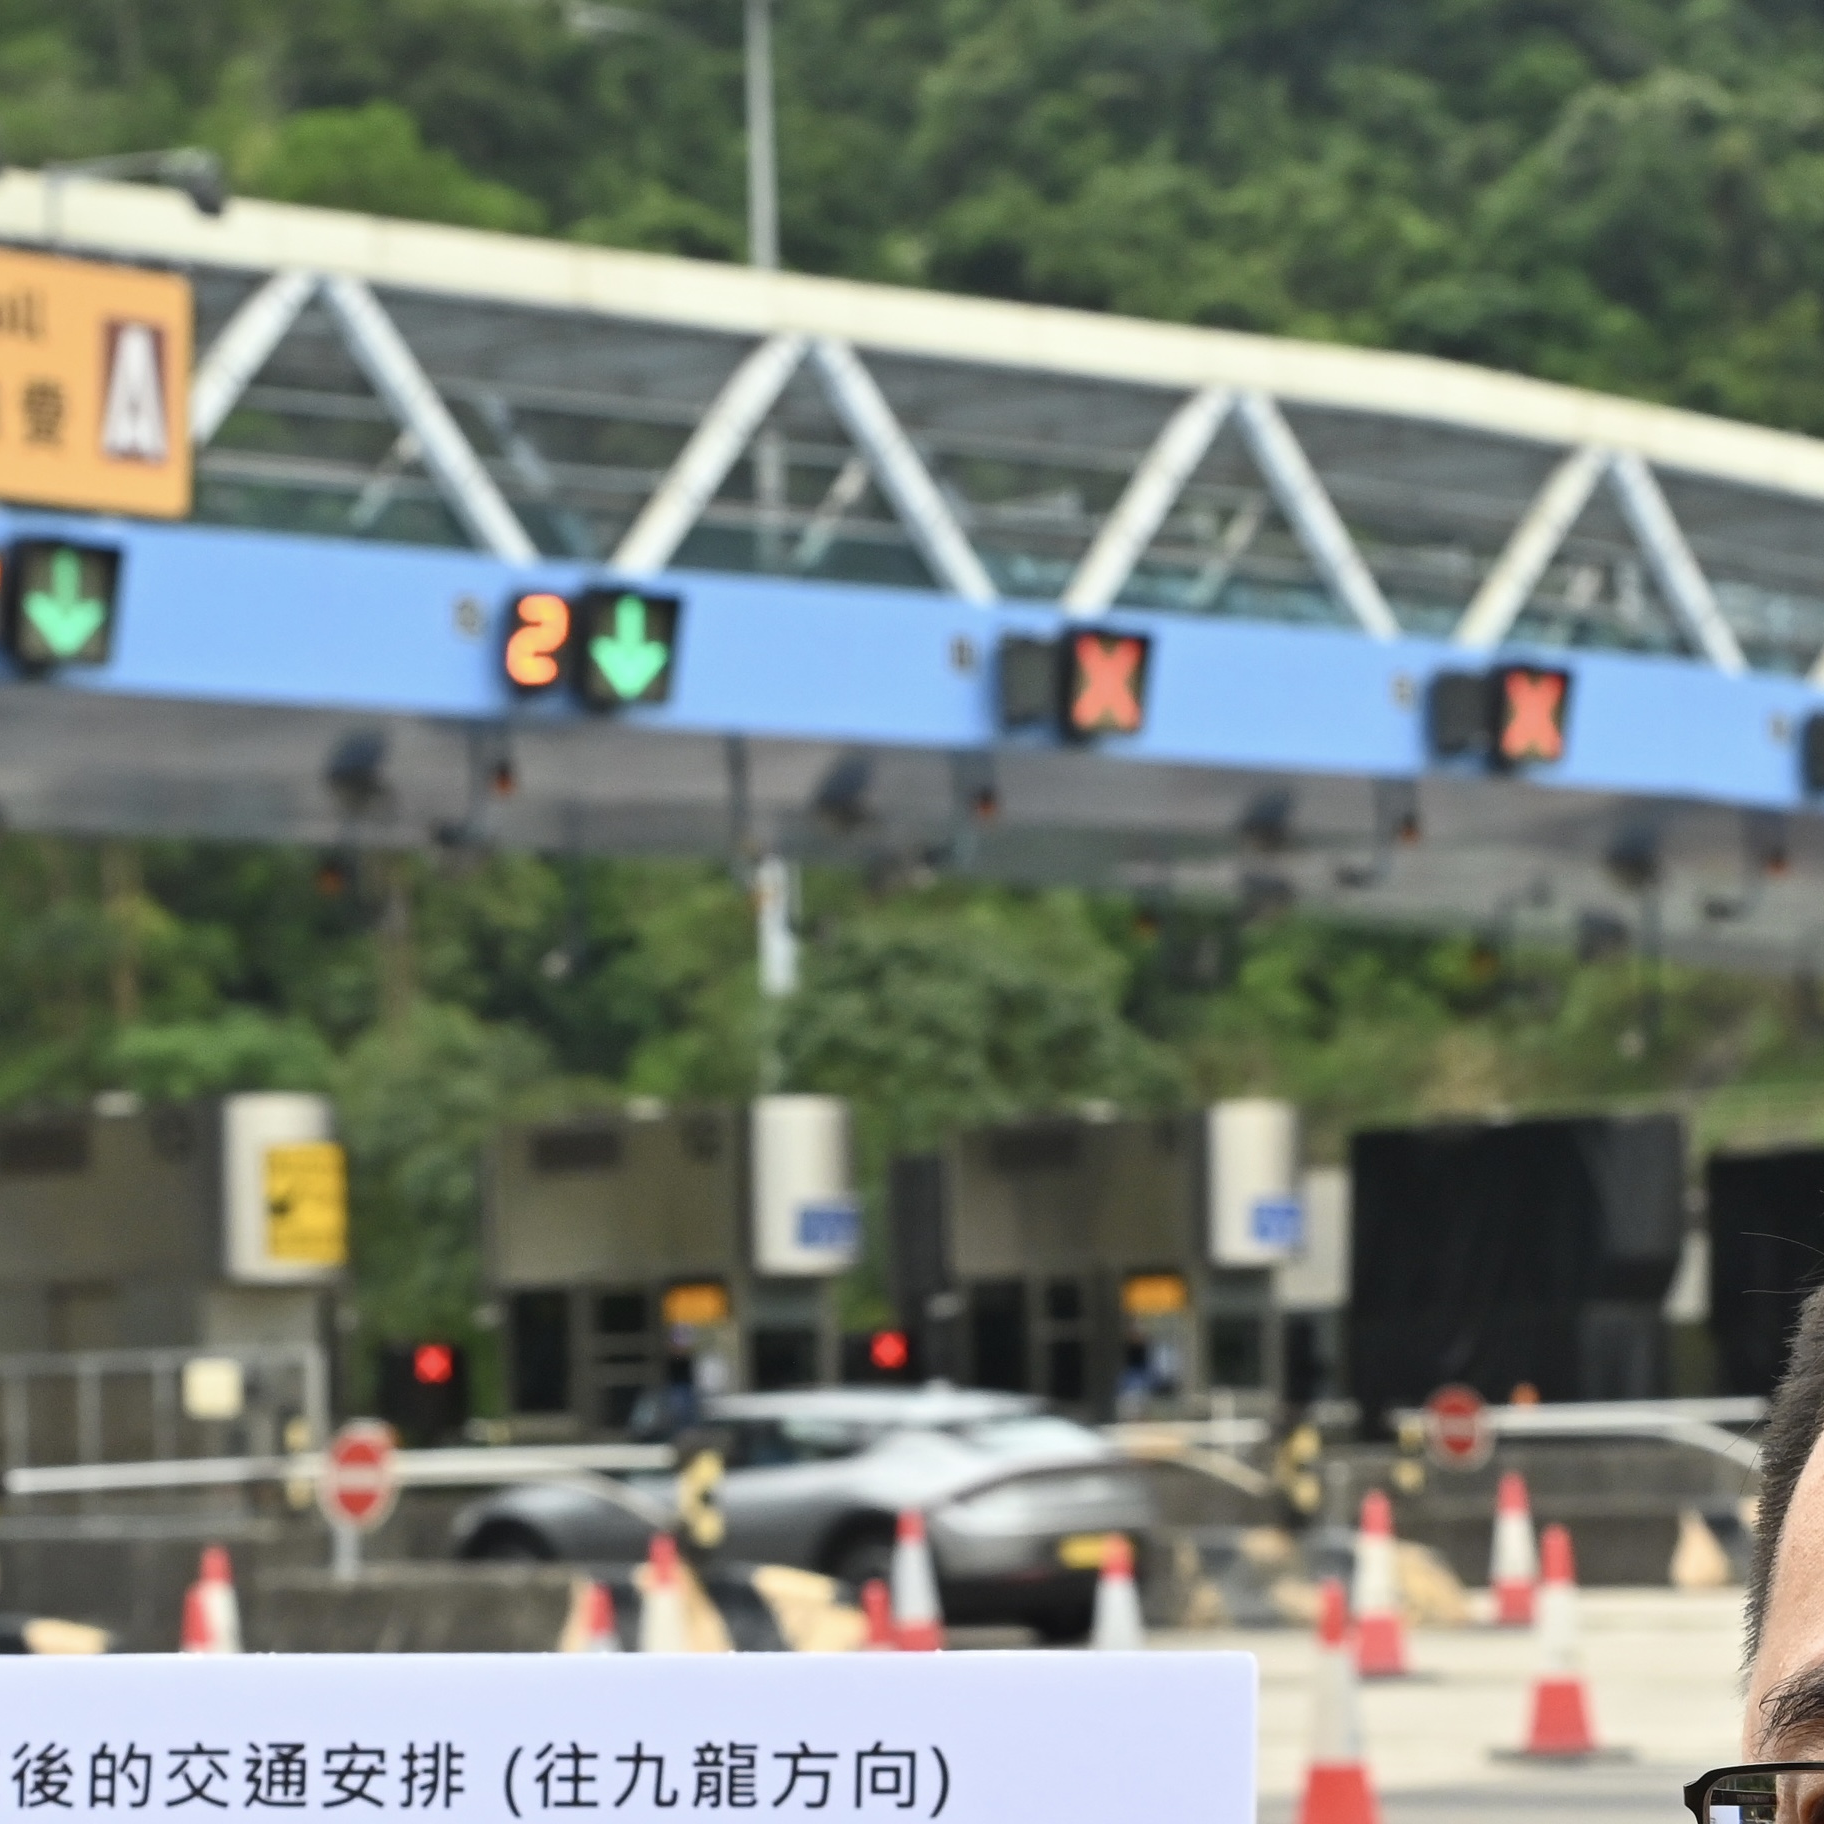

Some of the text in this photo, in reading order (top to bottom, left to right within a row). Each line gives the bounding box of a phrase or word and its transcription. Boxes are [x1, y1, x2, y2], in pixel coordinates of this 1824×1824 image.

[506, 593, 570, 687] 2
[503, 1740, 951, 1819] (往九龍方向)
